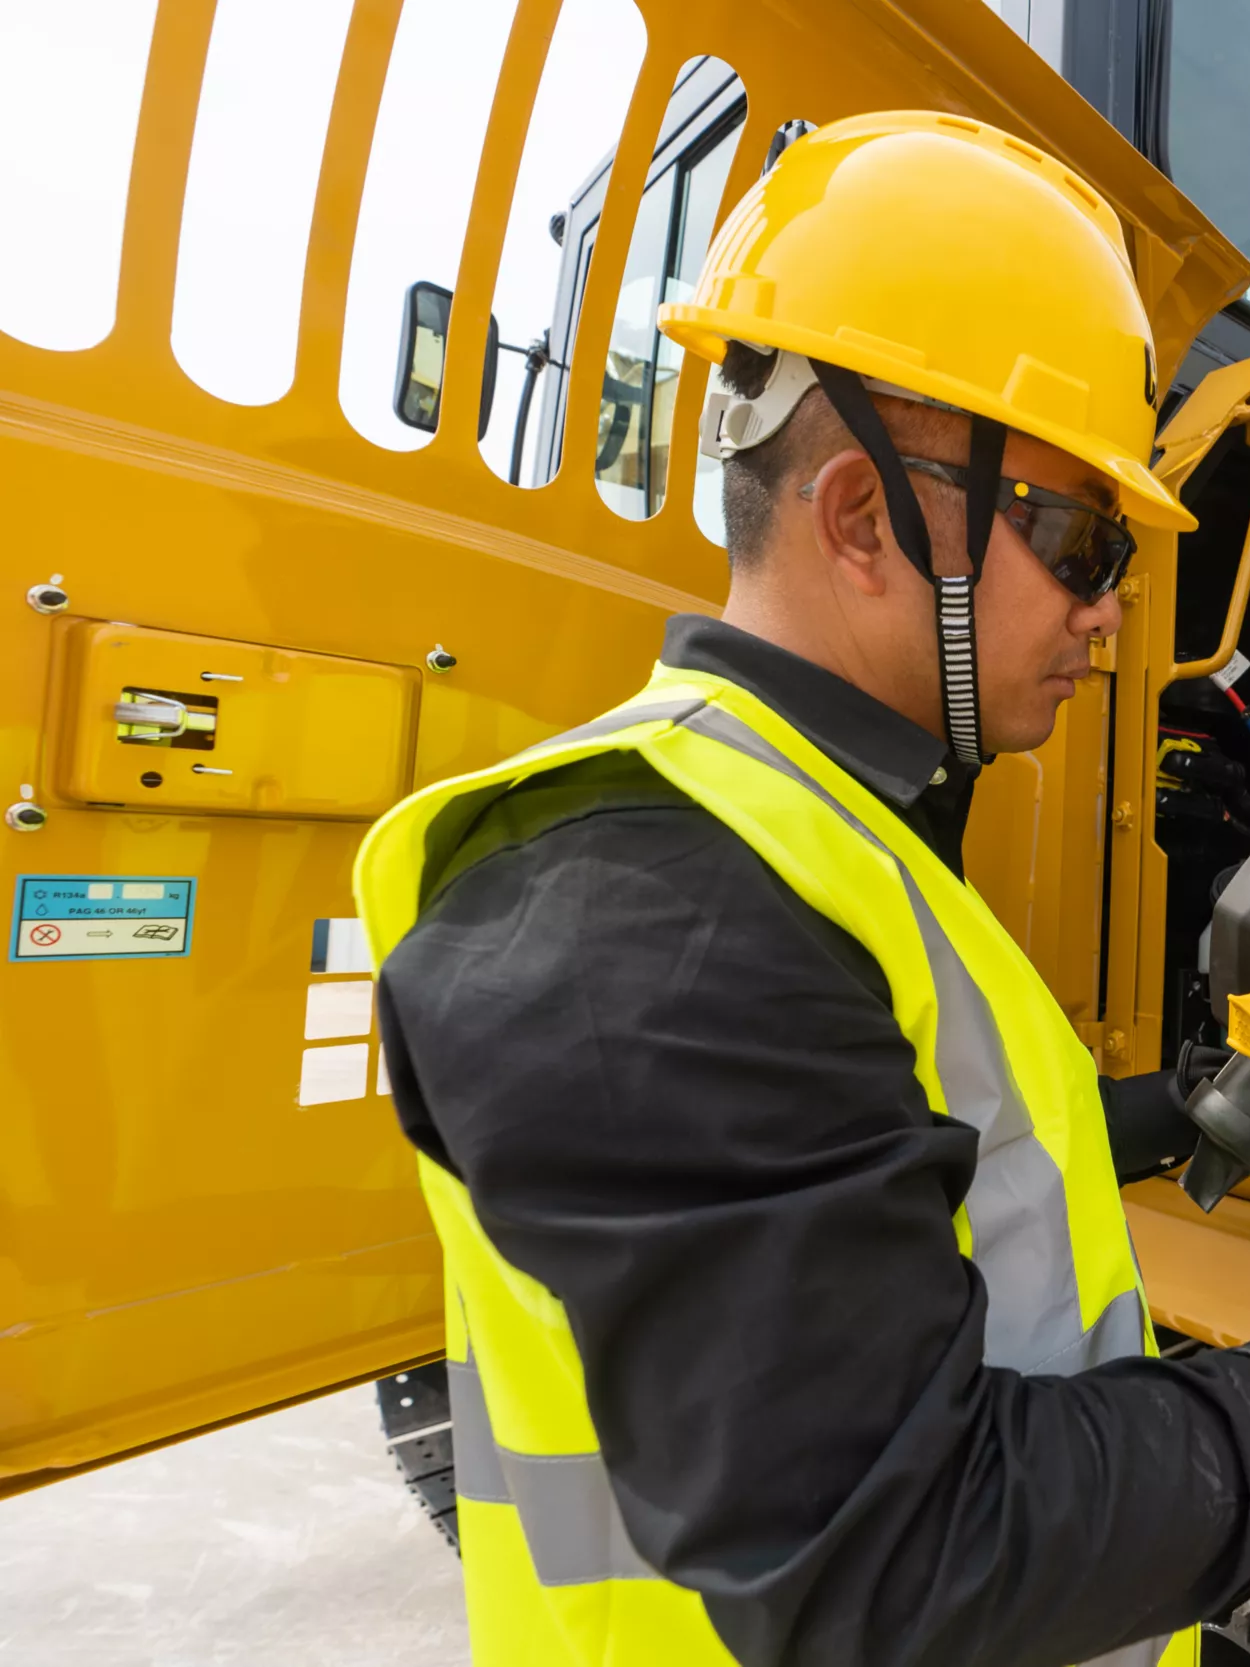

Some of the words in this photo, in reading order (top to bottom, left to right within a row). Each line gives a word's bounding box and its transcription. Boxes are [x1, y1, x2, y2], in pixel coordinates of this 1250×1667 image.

[53, 891, 86, 899] R134a
[68, 907, 92, 915] PAG
[94, 907, 106, 915] 46
[108, 907, 124, 915] OR
